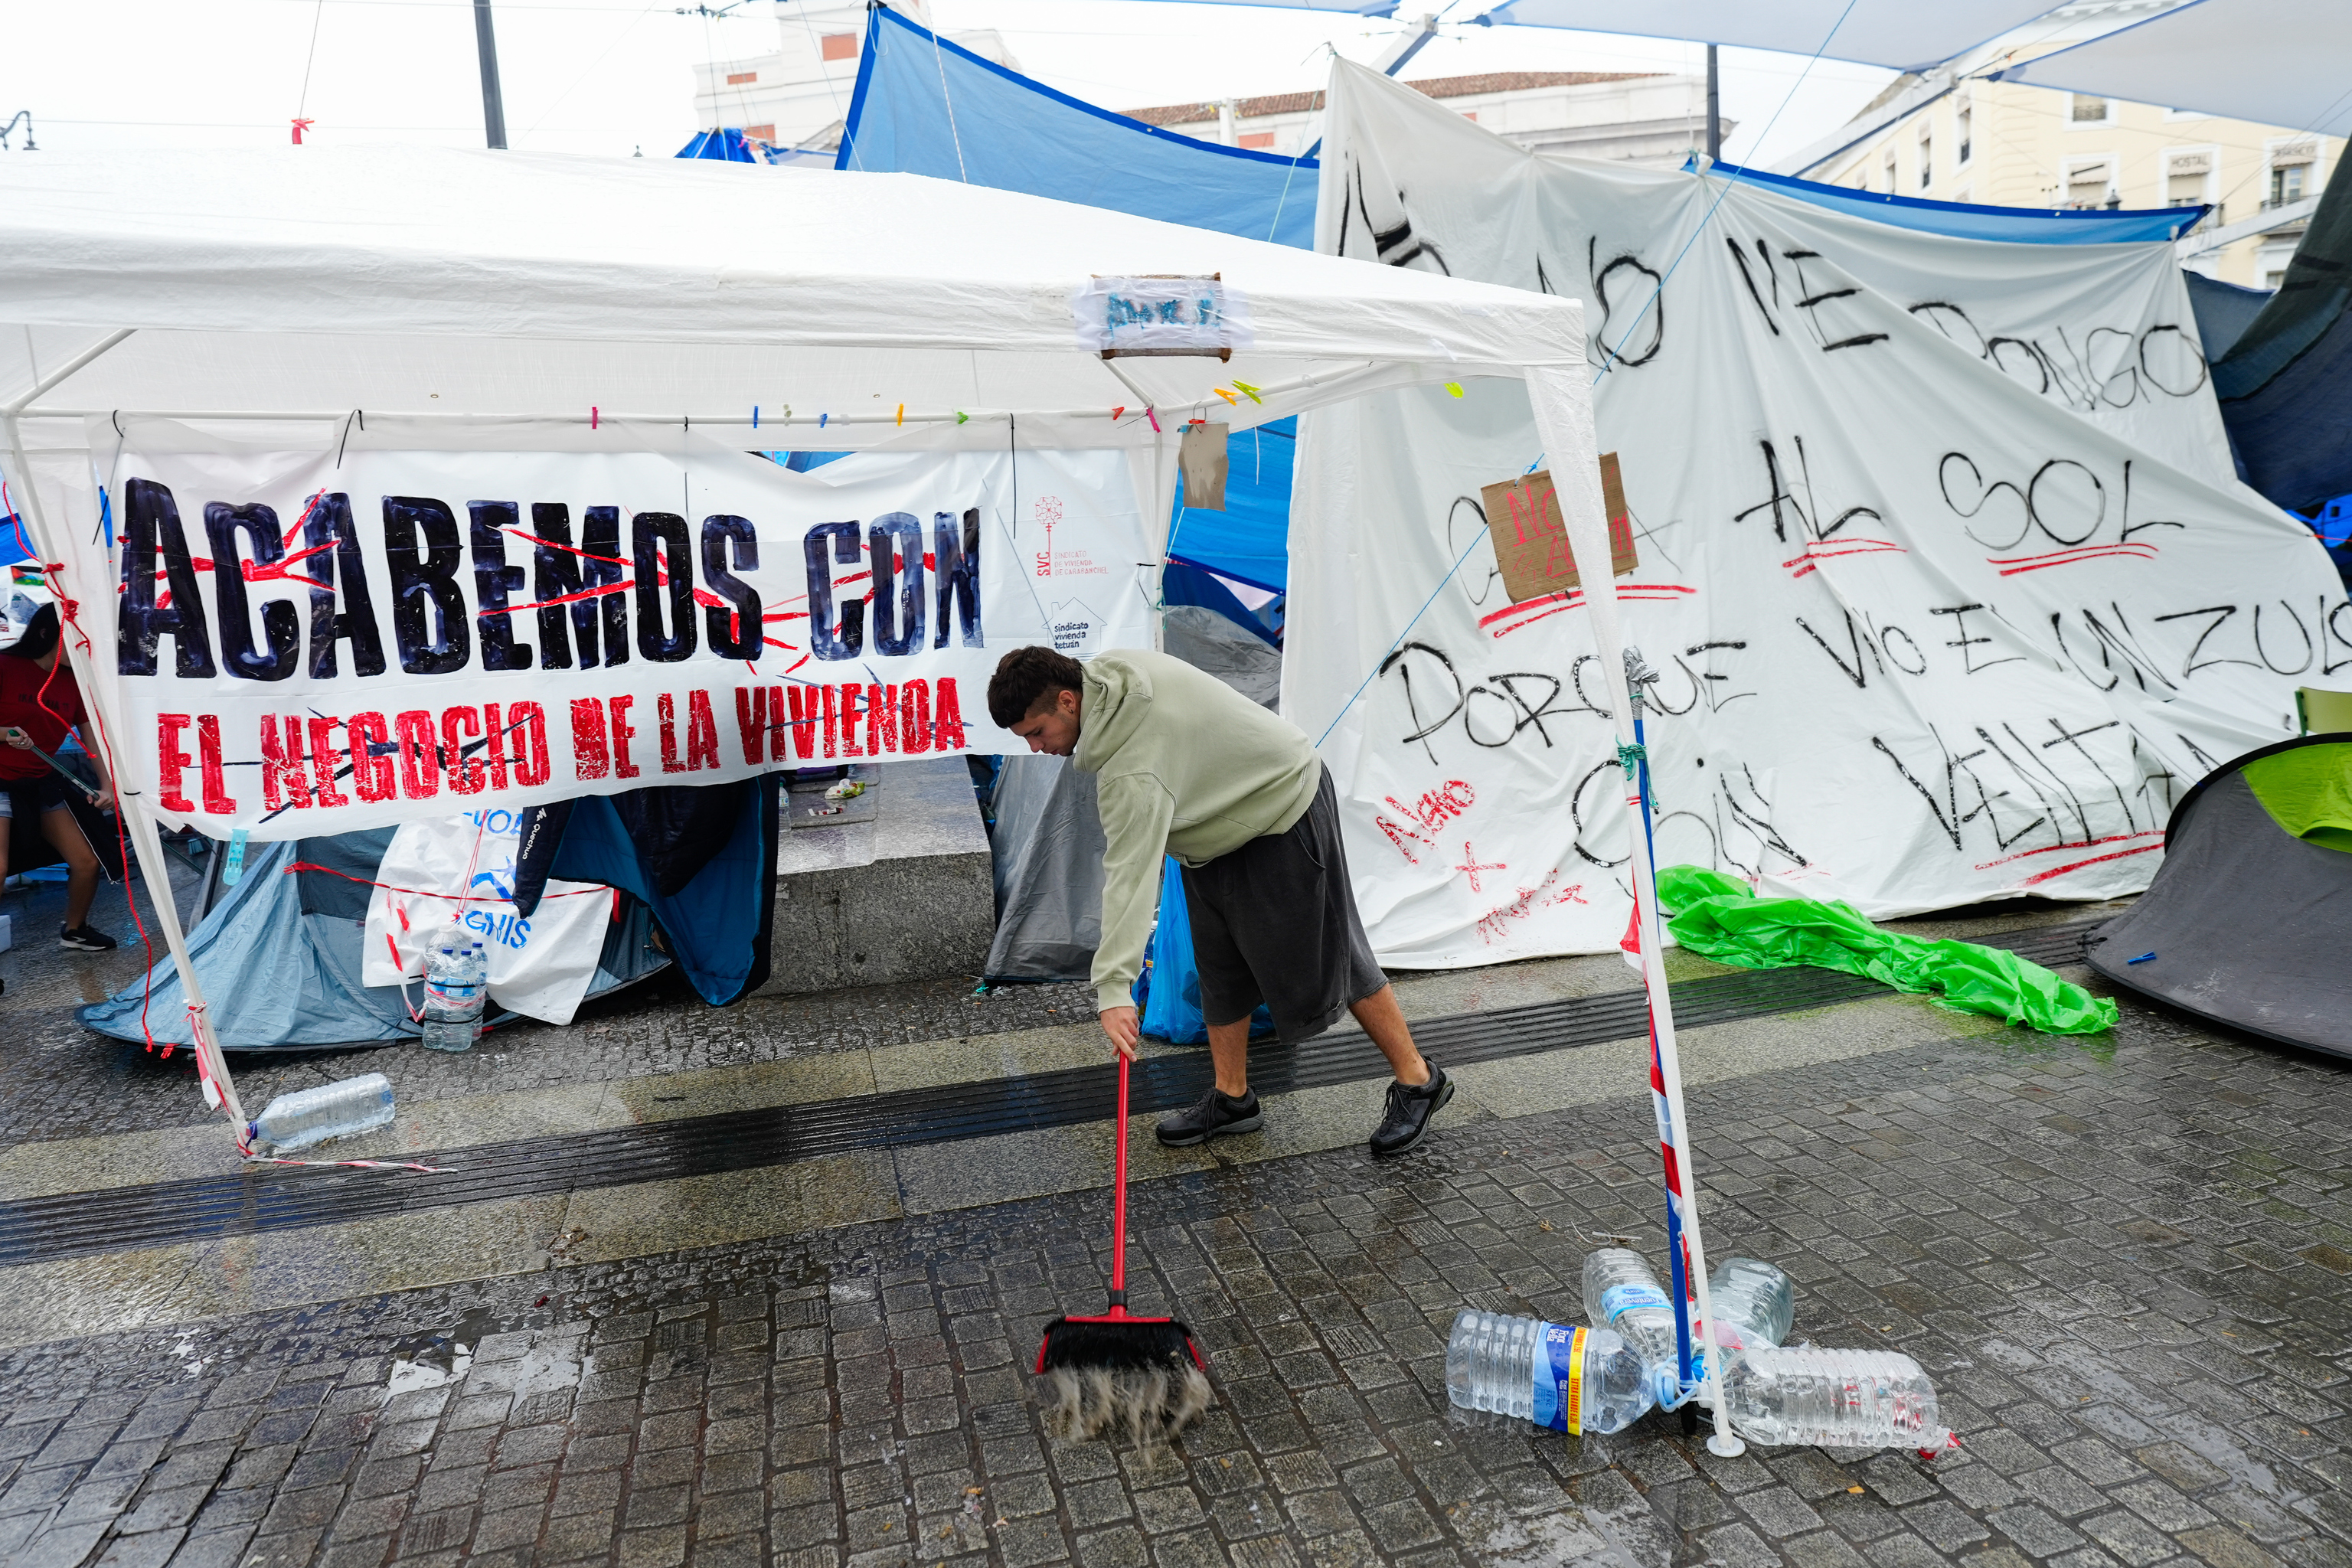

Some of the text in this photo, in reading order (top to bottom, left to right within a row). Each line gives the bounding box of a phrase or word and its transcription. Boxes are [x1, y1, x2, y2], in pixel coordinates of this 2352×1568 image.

[1939, 452, 2184, 551] SOL
[1054, 550, 1087, 559] SINDICATO
[1037, 551, 1050, 577] SVC
[1064, 559, 1093, 567] VIVIENDA
[1064, 567, 1109, 575] CARABANCHEL
[118, 476, 985, 681] ACABEMOS CON
[1054, 622, 1089, 632] sindicato
[1054, 631, 1086, 640] vivienda
[1054, 640, 1080, 649] tetuán
[157, 677, 966, 814] EL NEGOCIO DE LA VIVIENDA
[522, 823, 541, 860] Quechua
[1619, 1296, 1660, 1305] Fuentevera
[1547, 1328, 1559, 1341] Vella
[1558, 1329, 1569, 1343] Font
[1570, 1378, 1579, 1393] EXTRA
[1570, 1394, 1579, 1413] GRANDE
